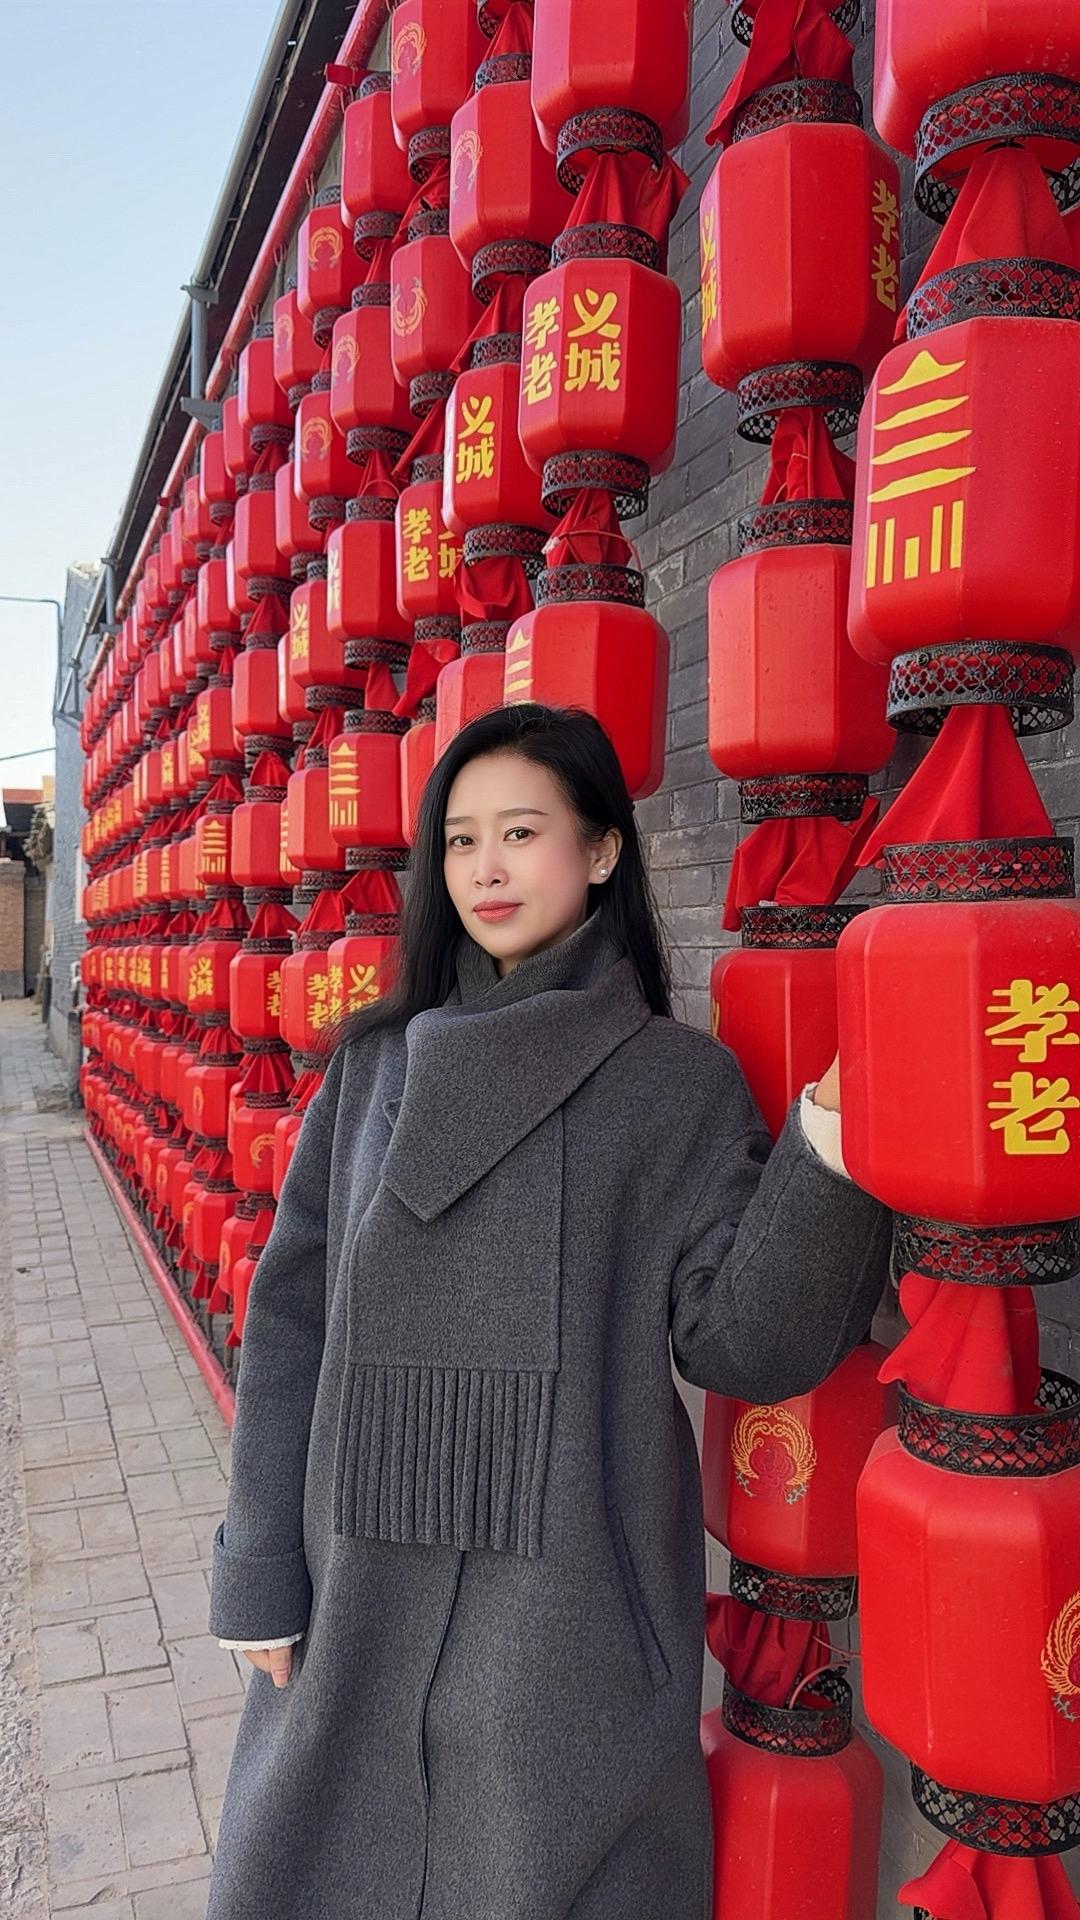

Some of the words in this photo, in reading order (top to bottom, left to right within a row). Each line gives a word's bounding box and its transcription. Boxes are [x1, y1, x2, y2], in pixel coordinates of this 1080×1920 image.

[872, 179, 899, 312] 孝老
[522, 296, 560, 405] 孝老
[564, 288, 621, 392] 义城
[456, 395, 495, 484] 义城
[402, 507, 432, 582] 孝老
[438, 530, 465, 578] 城
[292, 603, 308, 660] 义城
[306, 973, 328, 1029] 孝老
[985, 979, 1080, 1155] 孝老
